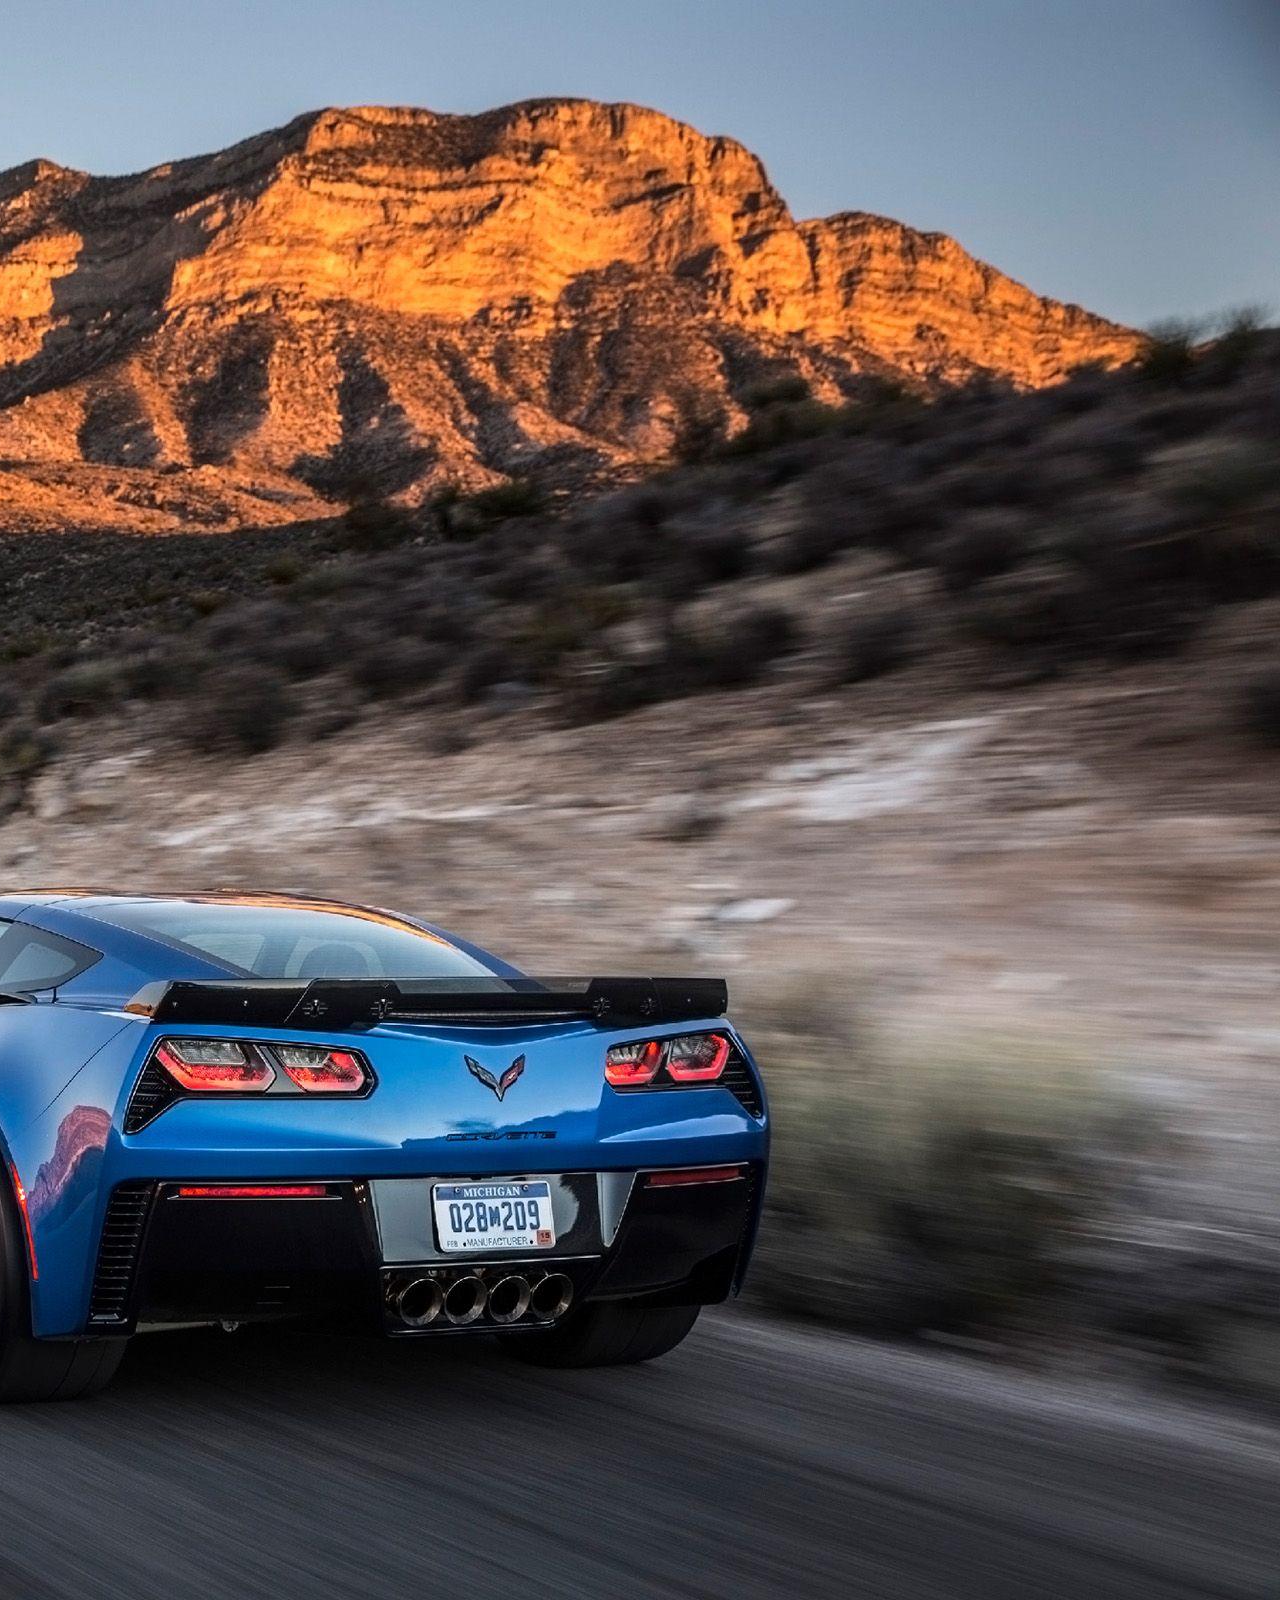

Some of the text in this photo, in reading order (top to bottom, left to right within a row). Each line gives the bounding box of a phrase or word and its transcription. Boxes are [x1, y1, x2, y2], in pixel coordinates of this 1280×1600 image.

[463, 1186, 521, 1198] MICHIGAN
[449, 1200, 540, 1232] 028M209
[466, 1236, 528, 1247] MANUFACTURER
